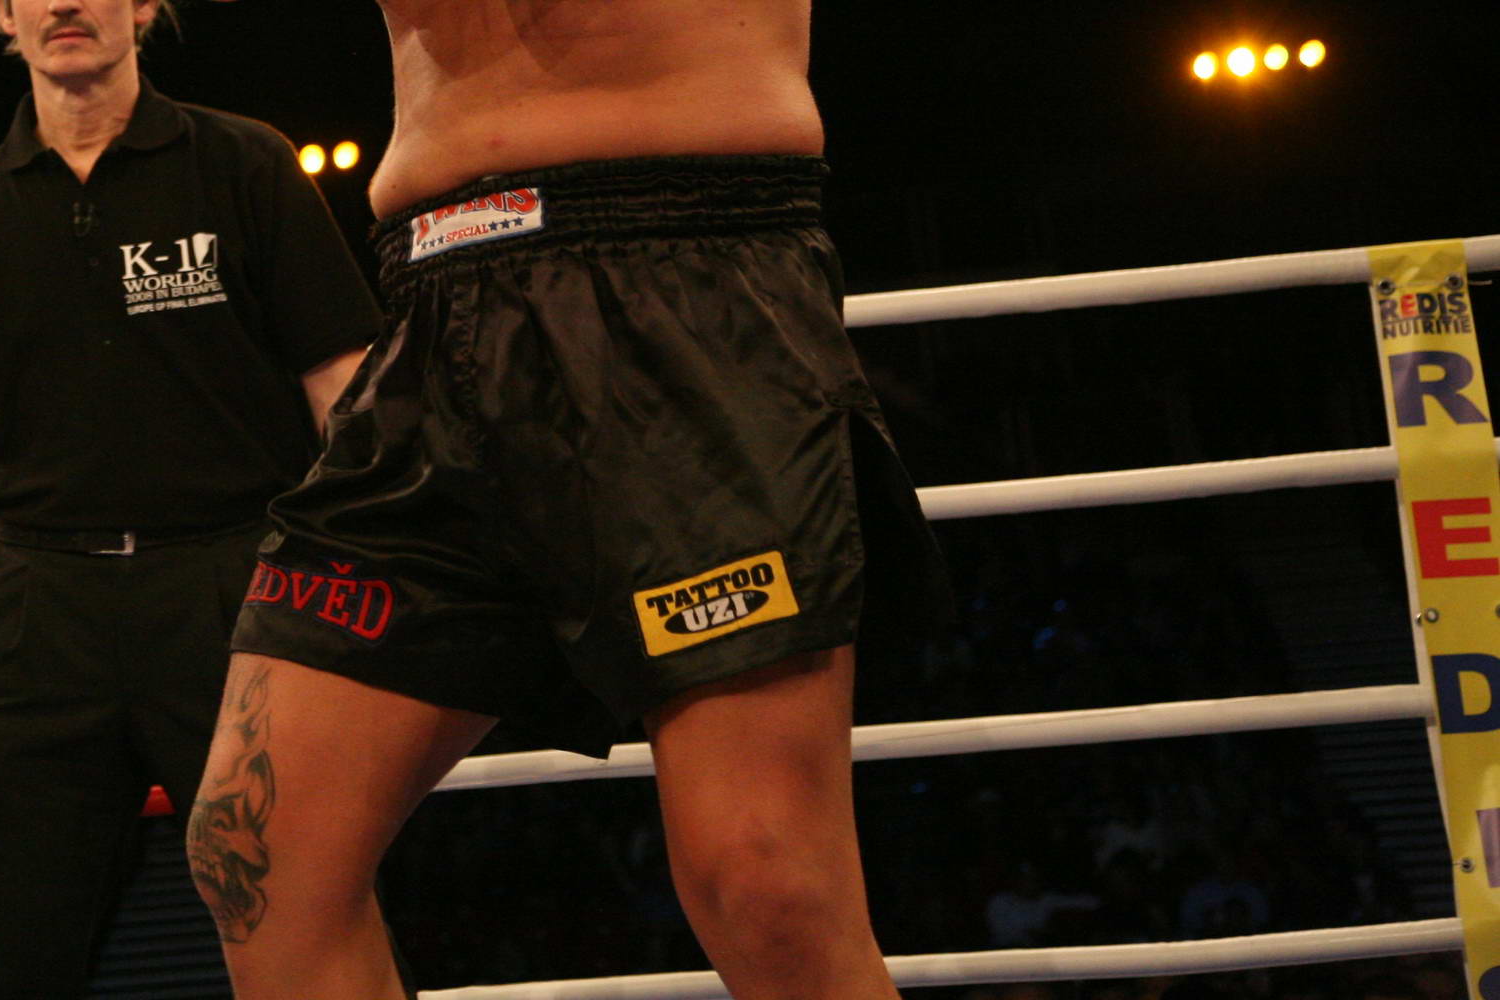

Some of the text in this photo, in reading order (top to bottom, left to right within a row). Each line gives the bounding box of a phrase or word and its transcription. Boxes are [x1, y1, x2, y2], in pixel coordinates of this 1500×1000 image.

[445, 223, 489, 243] SPECIAL
[119, 238, 196, 279] K-1
[1379, 291, 1467, 321] REDIS
[646, 563, 774, 617] TATTOO
[682, 592, 749, 632] UZI
